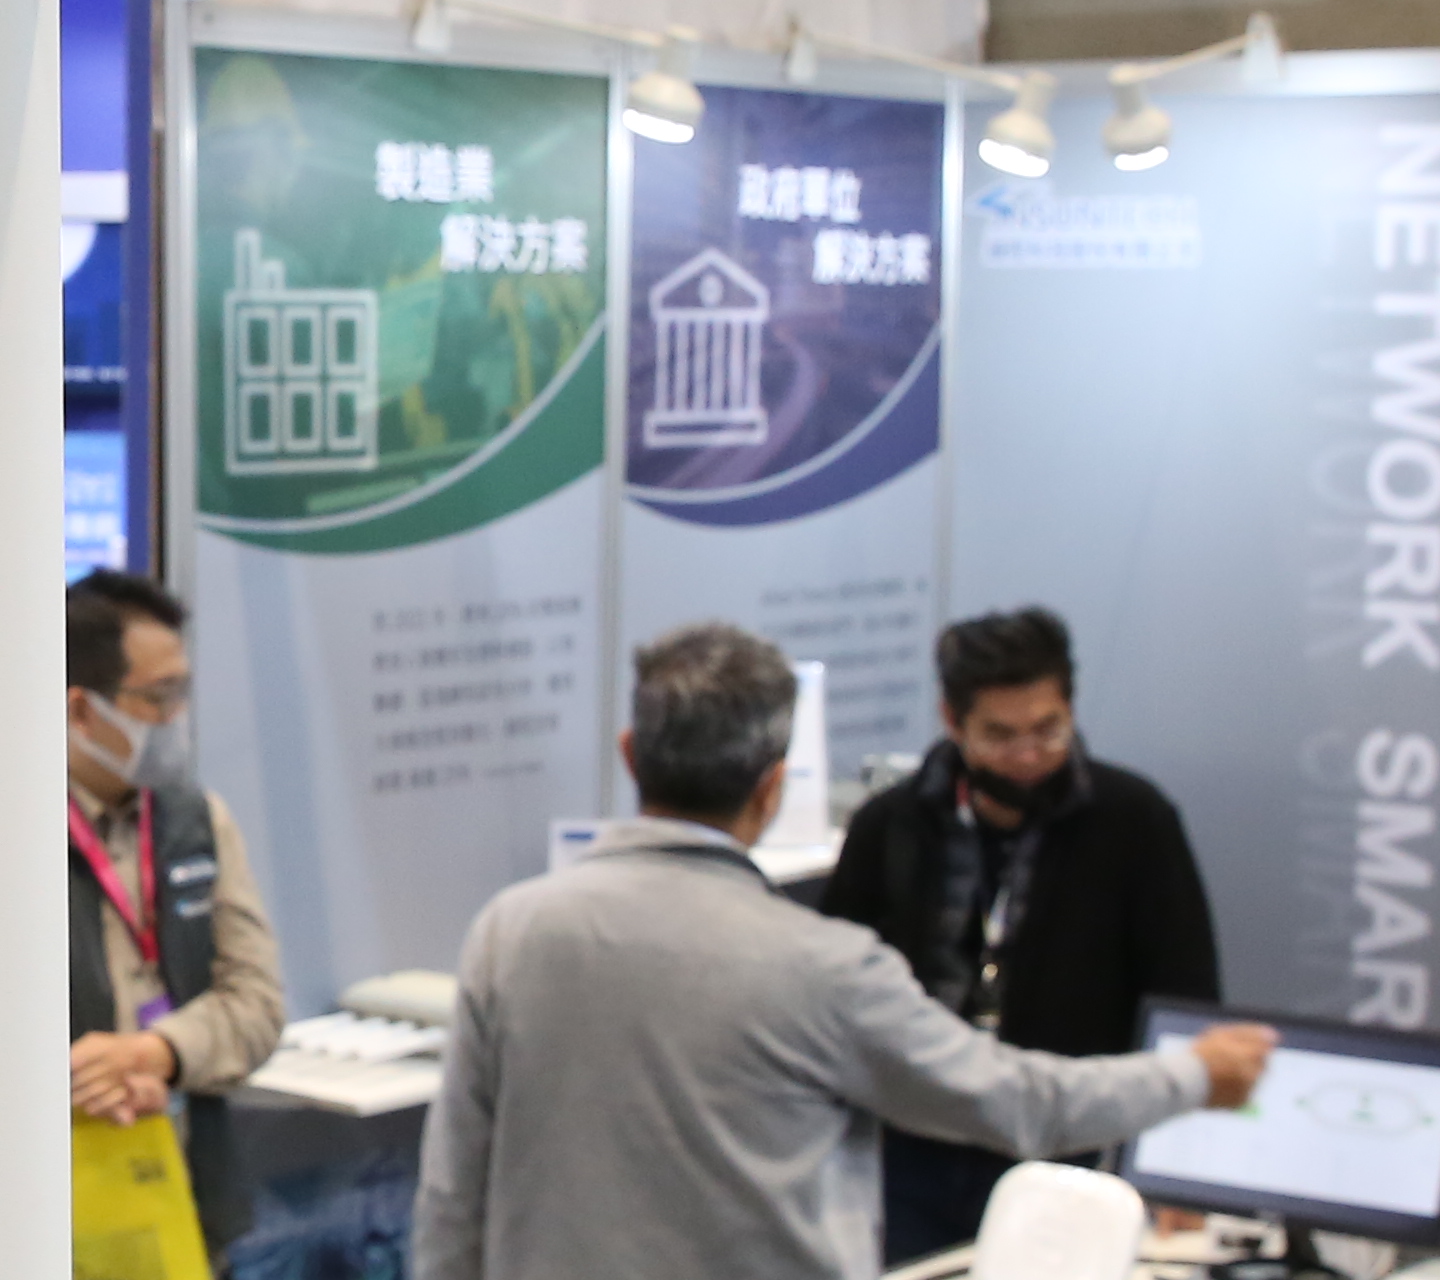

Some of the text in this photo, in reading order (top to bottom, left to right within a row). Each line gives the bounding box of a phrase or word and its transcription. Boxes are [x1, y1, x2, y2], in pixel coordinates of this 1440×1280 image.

[440, 214, 588, 273] 解決方案
[812, 230, 931, 286] 解決方案
